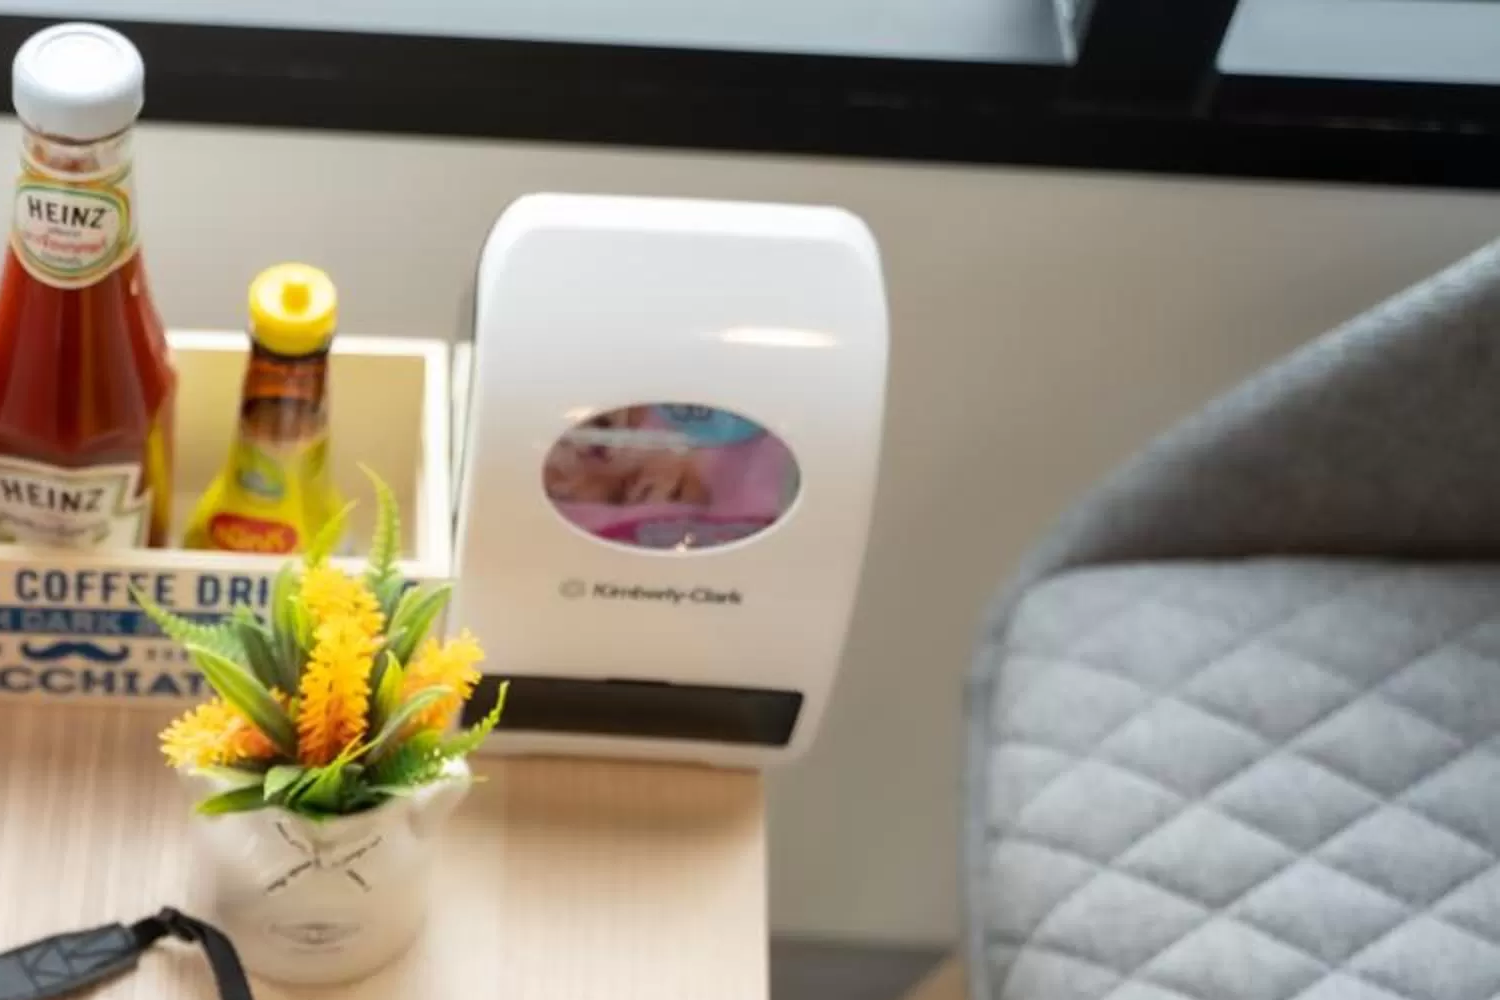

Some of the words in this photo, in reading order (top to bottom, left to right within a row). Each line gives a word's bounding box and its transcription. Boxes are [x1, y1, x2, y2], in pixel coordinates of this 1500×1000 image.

[28, 195, 108, 229] HEINZ
[1, 479, 105, 513] HEINZ
[15, 568, 177, 606] COFFEE
[197, 575, 269, 606] DRI
